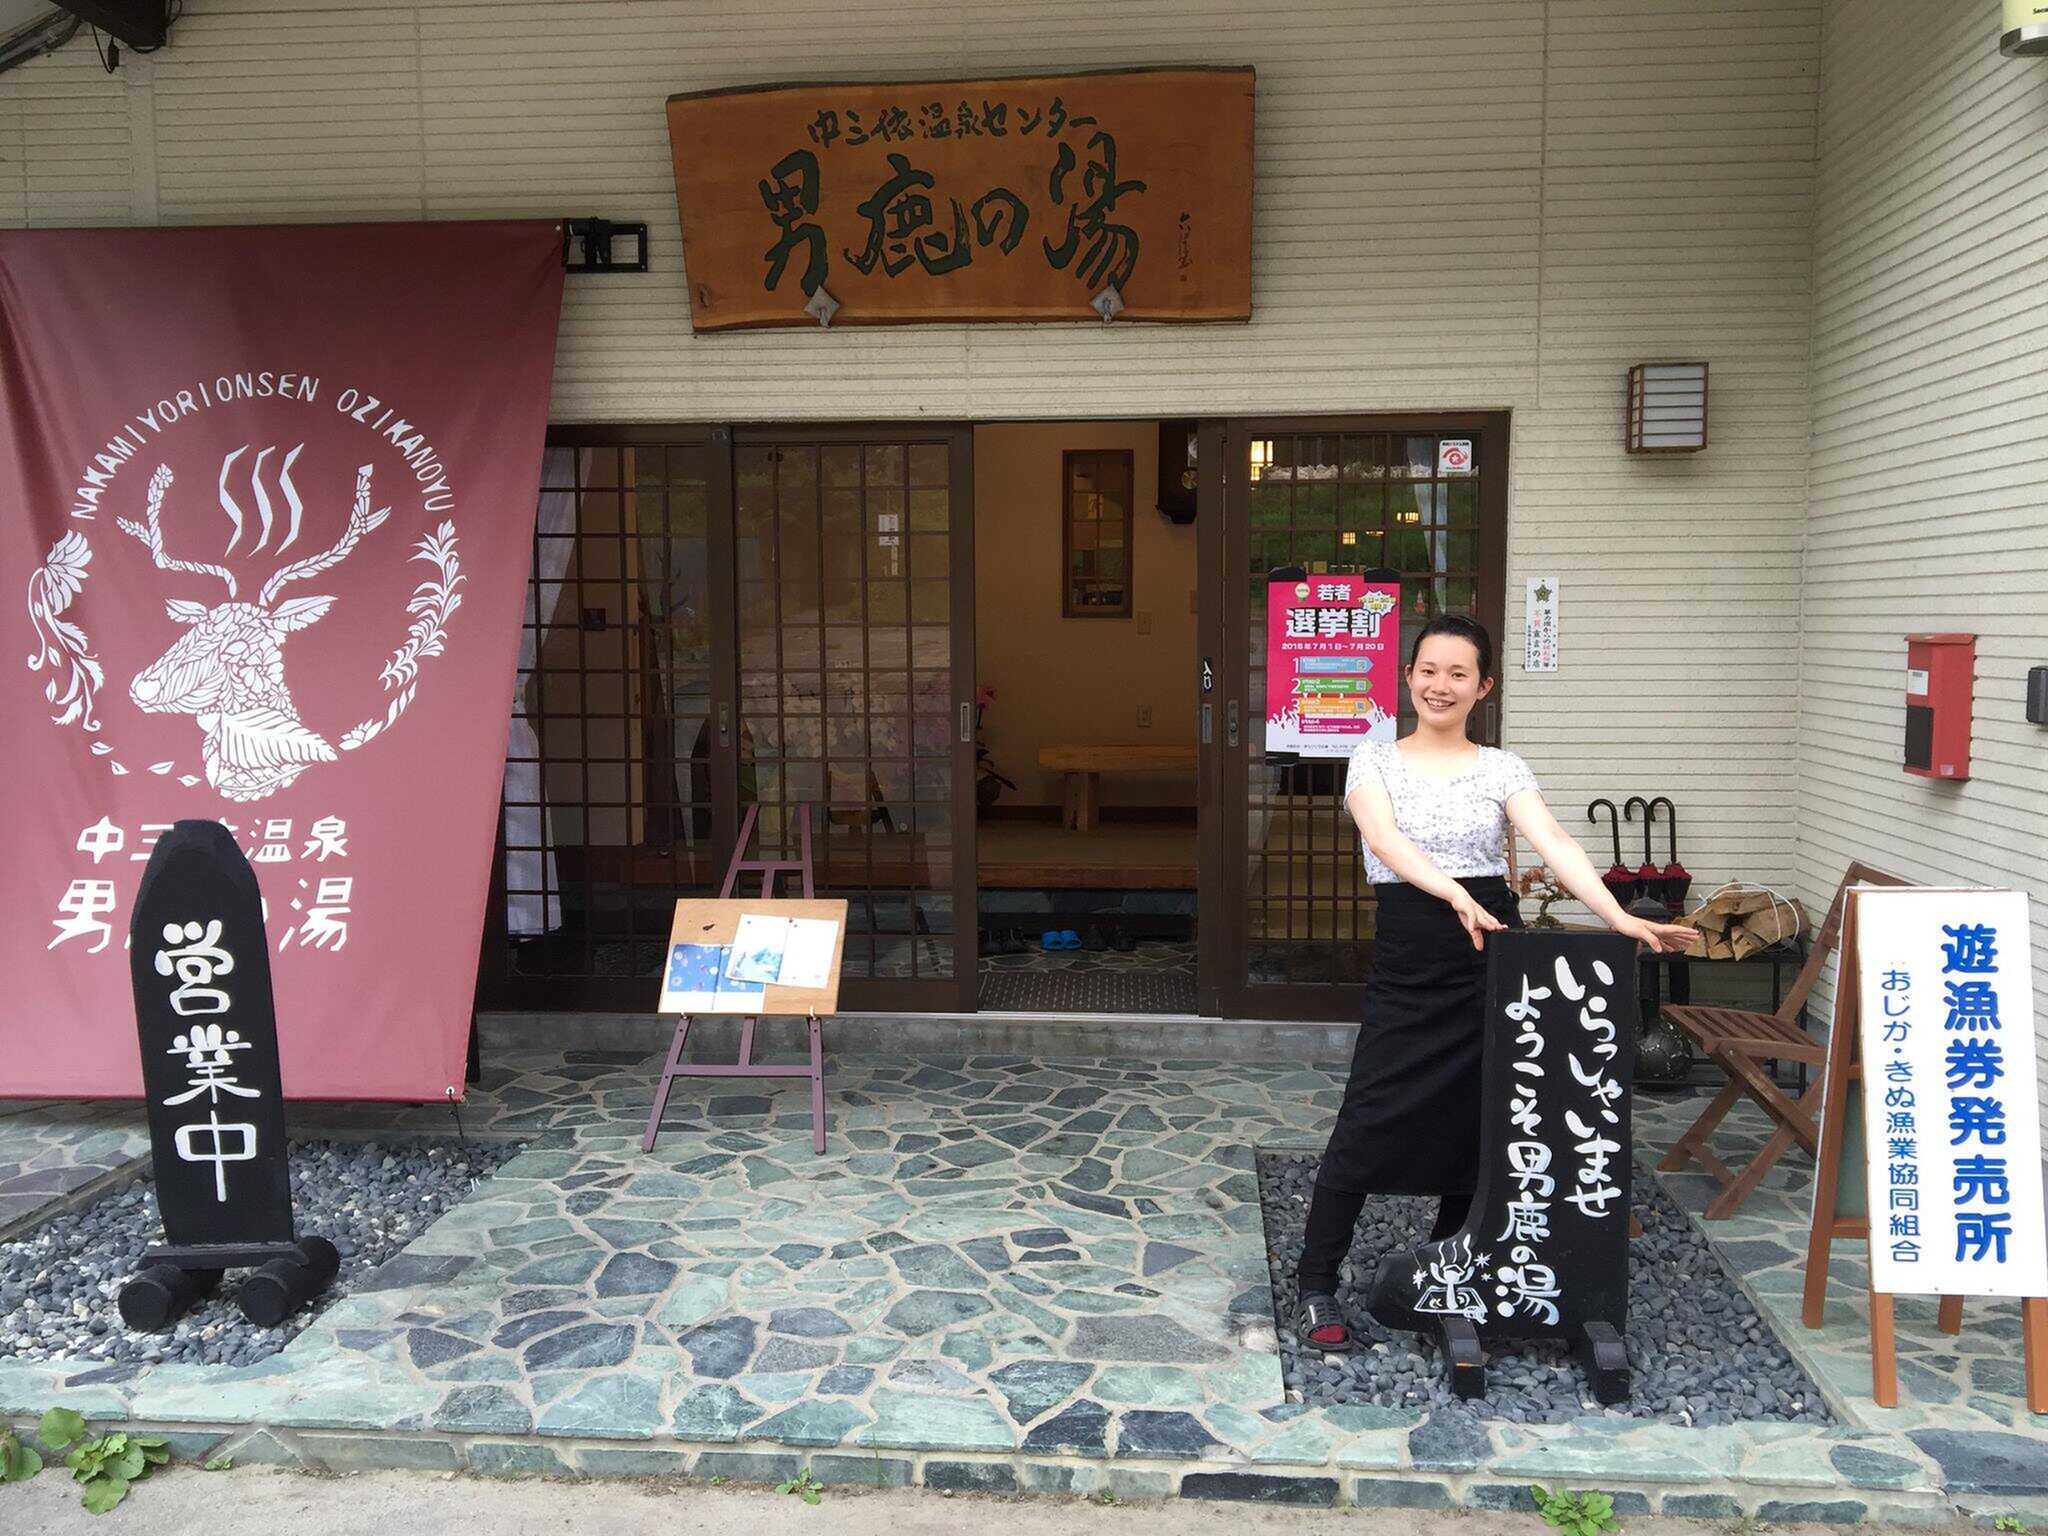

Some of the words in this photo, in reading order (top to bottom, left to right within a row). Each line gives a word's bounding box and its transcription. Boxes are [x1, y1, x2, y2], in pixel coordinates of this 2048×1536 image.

[809, 97, 1097, 148] 中三依温泉センター
[758, 131, 1147, 297] 男鹿の湯
[71, 372, 319, 520] NAKAMIYORIONSEN
[337, 388, 455, 512] OZIKANOYU
[1285, 608, 1381, 638] 選挙割
[1317, 584, 1351, 601] 若者
[47, 877, 353, 954] 男湯
[76, 815, 349, 864] 中三温泉
[154, 919, 261, 1202] 営業中
[1554, 955, 1624, 1218] いらっしゃいませ
[1881, 968, 1921, 1263] おじか・きぬ漁業協同組合
[1941, 923, 2012, 1264] 遊漁券発売所
[1496, 973, 1562, 1326] ようこそ男鹿の湯
